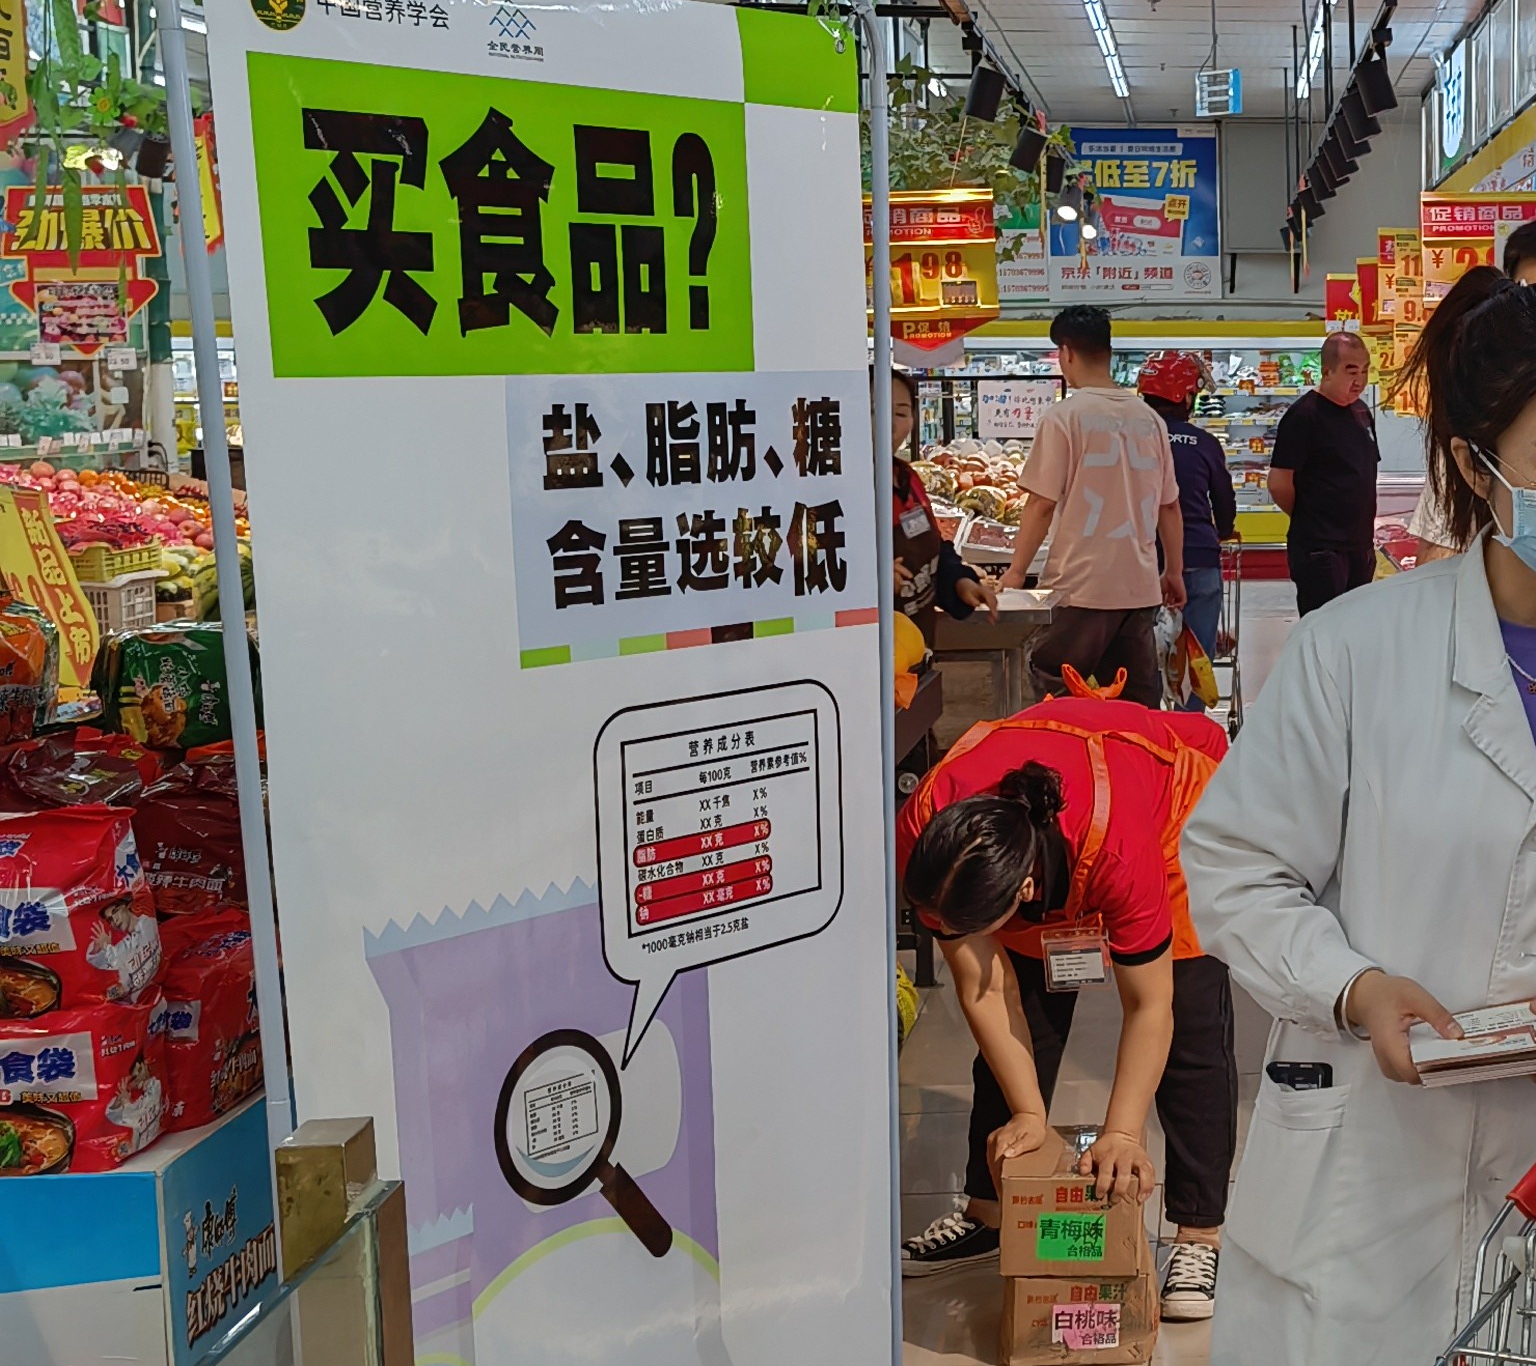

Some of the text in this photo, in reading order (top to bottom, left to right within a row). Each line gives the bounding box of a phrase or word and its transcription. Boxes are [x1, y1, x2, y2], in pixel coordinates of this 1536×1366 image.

[1430, 205, 1523, 222] 促销商品
[542, 396, 843, 491] 盐、脂肪、糖
[546, 497, 848, 610] 含量选较低
[20, 508, 91, 665] 新品上市
[689, 731, 755, 757] 营养成分表
[634, 780, 653, 795] 项目
[699, 767, 732, 784] 每100克
[636, 809, 654, 825] 能量
[637, 828, 664, 844] 蛋白质
[636, 847, 656, 864] 脂肪
[637, 861, 684, 882] 碳水化合物
[1040, 1218, 1104, 1241] 青梅味
[186, 1223, 278, 1350] 红烧牛肉面
[1055, 1310, 1118, 1331] 白桃味
[1081, 1333, 1116, 1345] 合格品
